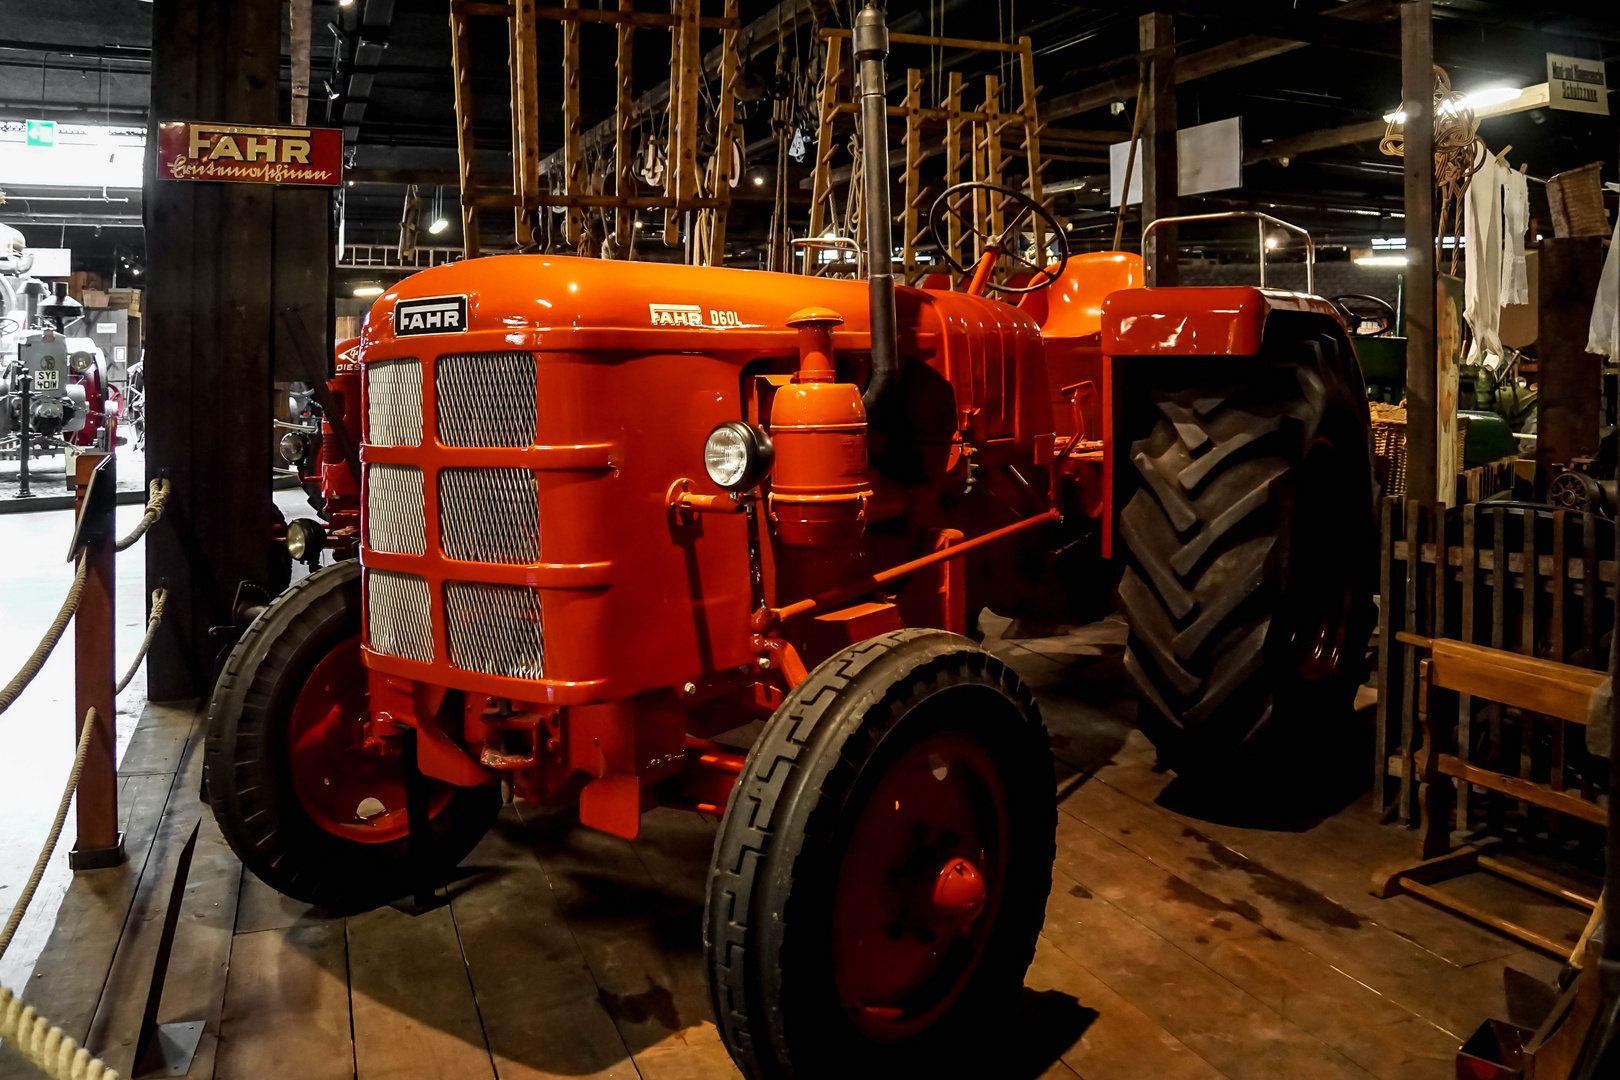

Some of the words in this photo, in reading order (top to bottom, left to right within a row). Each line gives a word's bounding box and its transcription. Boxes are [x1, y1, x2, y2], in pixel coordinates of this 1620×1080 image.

[188, 124, 311, 164] FAHR
[400, 302, 460, 331] FAHR
[649, 303, 703, 326] FAHR
[710, 309, 743, 326] D60L
[38, 371, 57, 380] SYB
